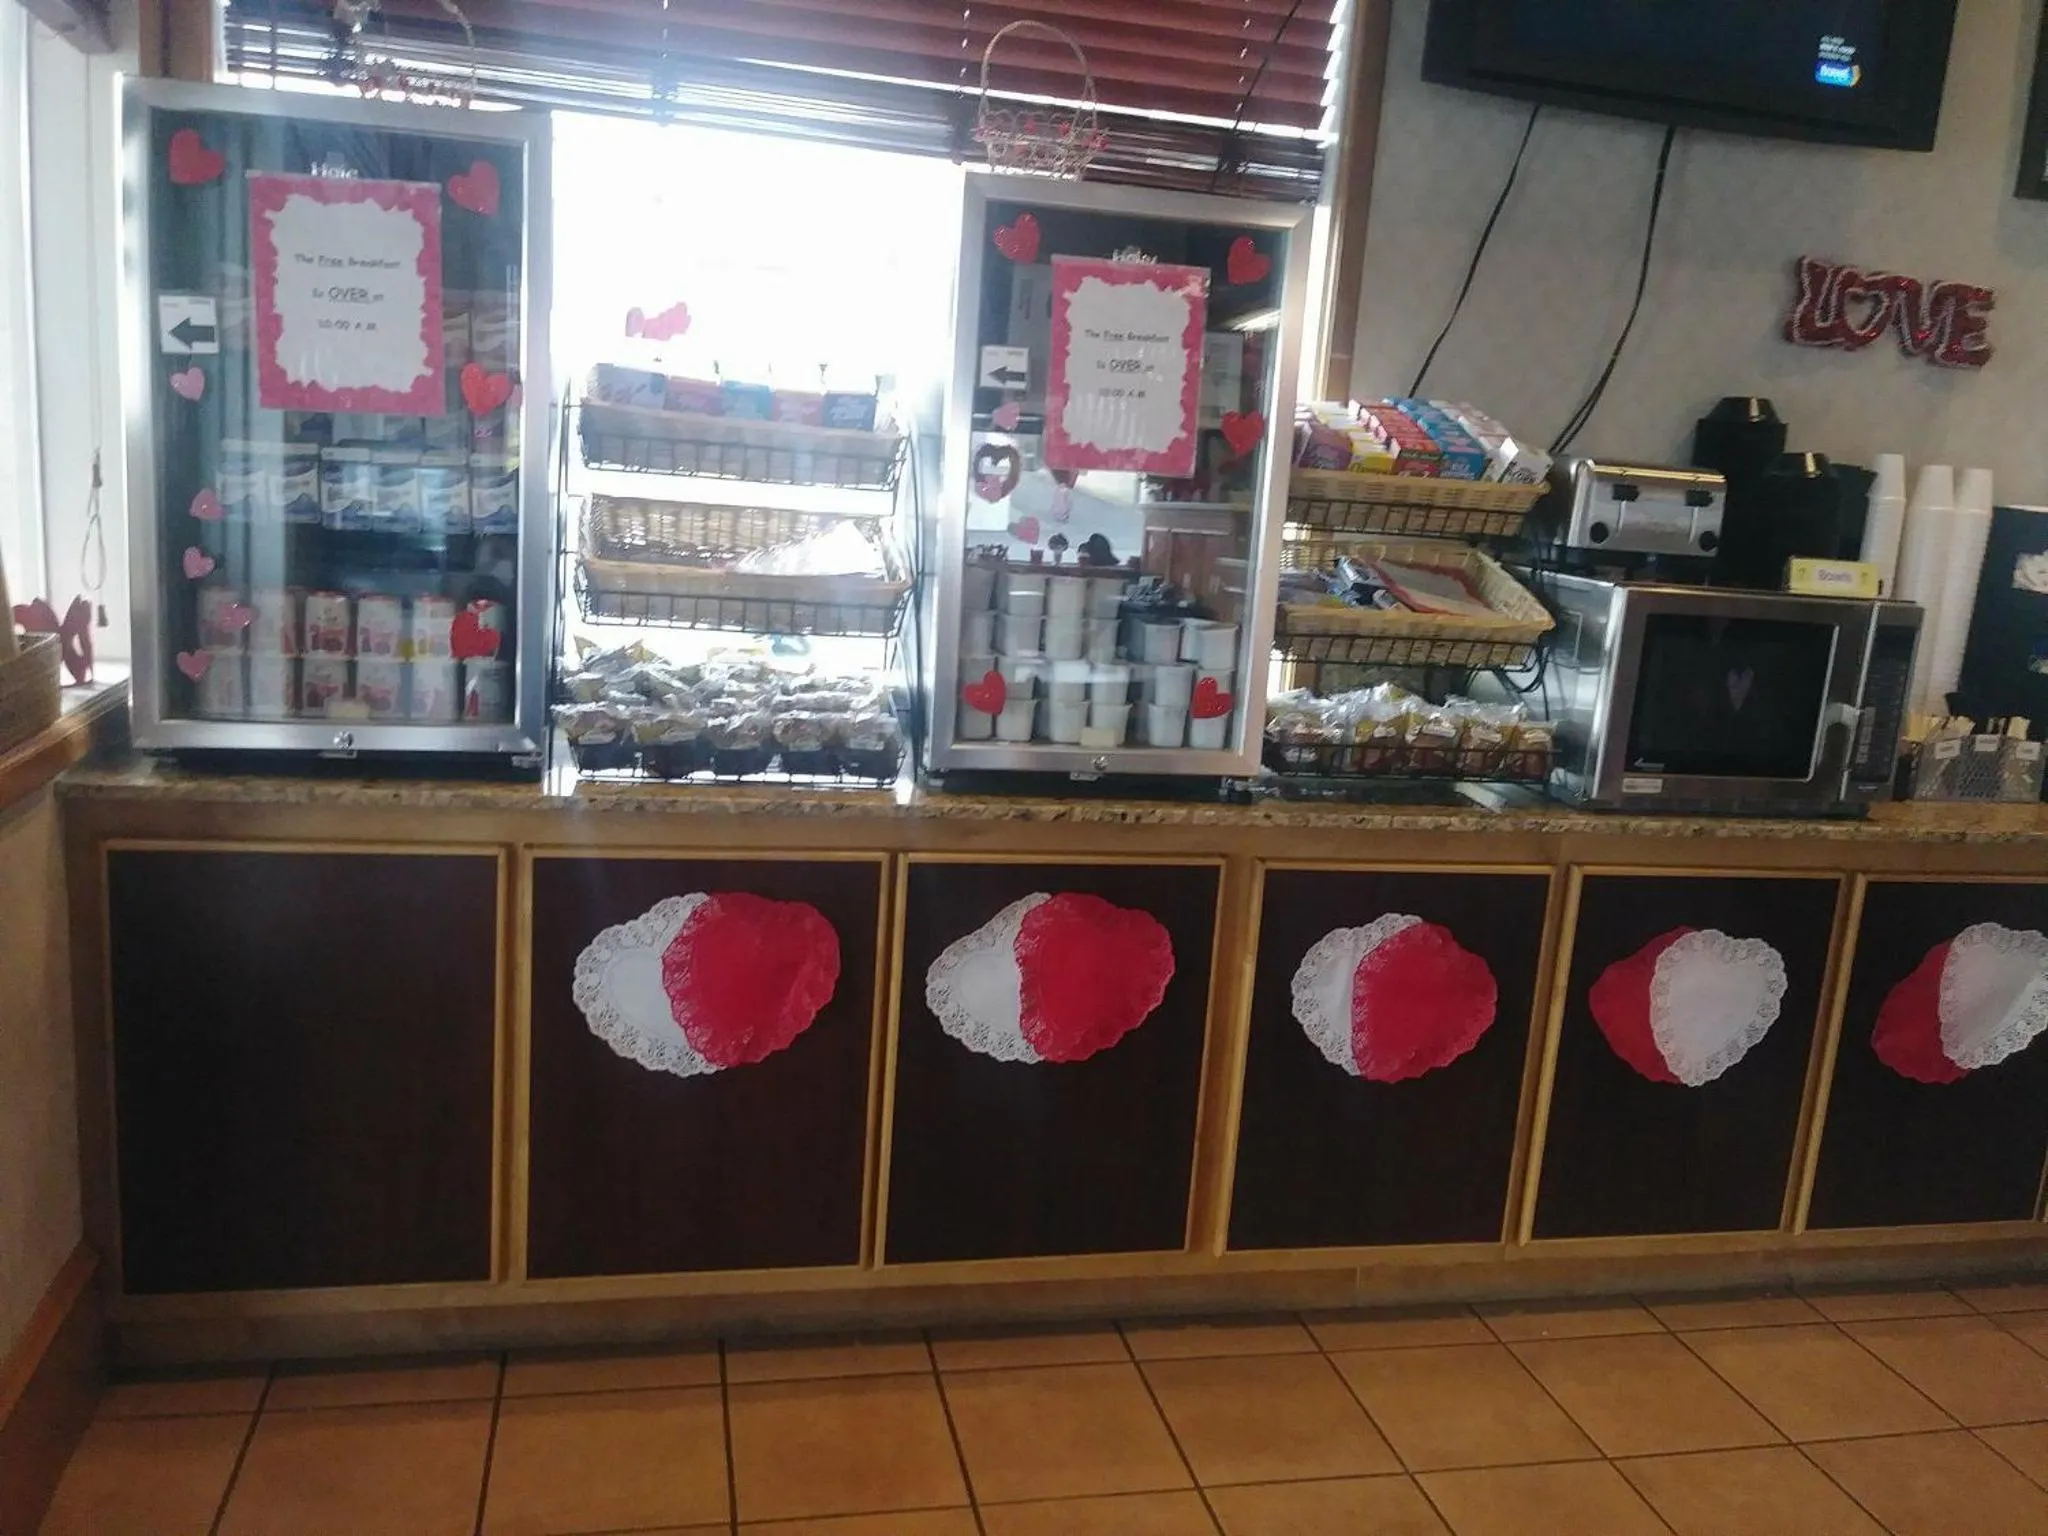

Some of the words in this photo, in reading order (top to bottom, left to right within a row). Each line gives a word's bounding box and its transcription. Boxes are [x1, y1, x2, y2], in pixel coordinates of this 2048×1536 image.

[294, 253, 314, 264] The
[318, 255, 343, 267] Free
[328, 286, 369, 301] OVER
[1786, 255, 1995, 368] LOVE
[1085, 328, 1100, 338] The
[1103, 329, 1124, 341] Free
[1109, 359, 1143, 373] OVER
